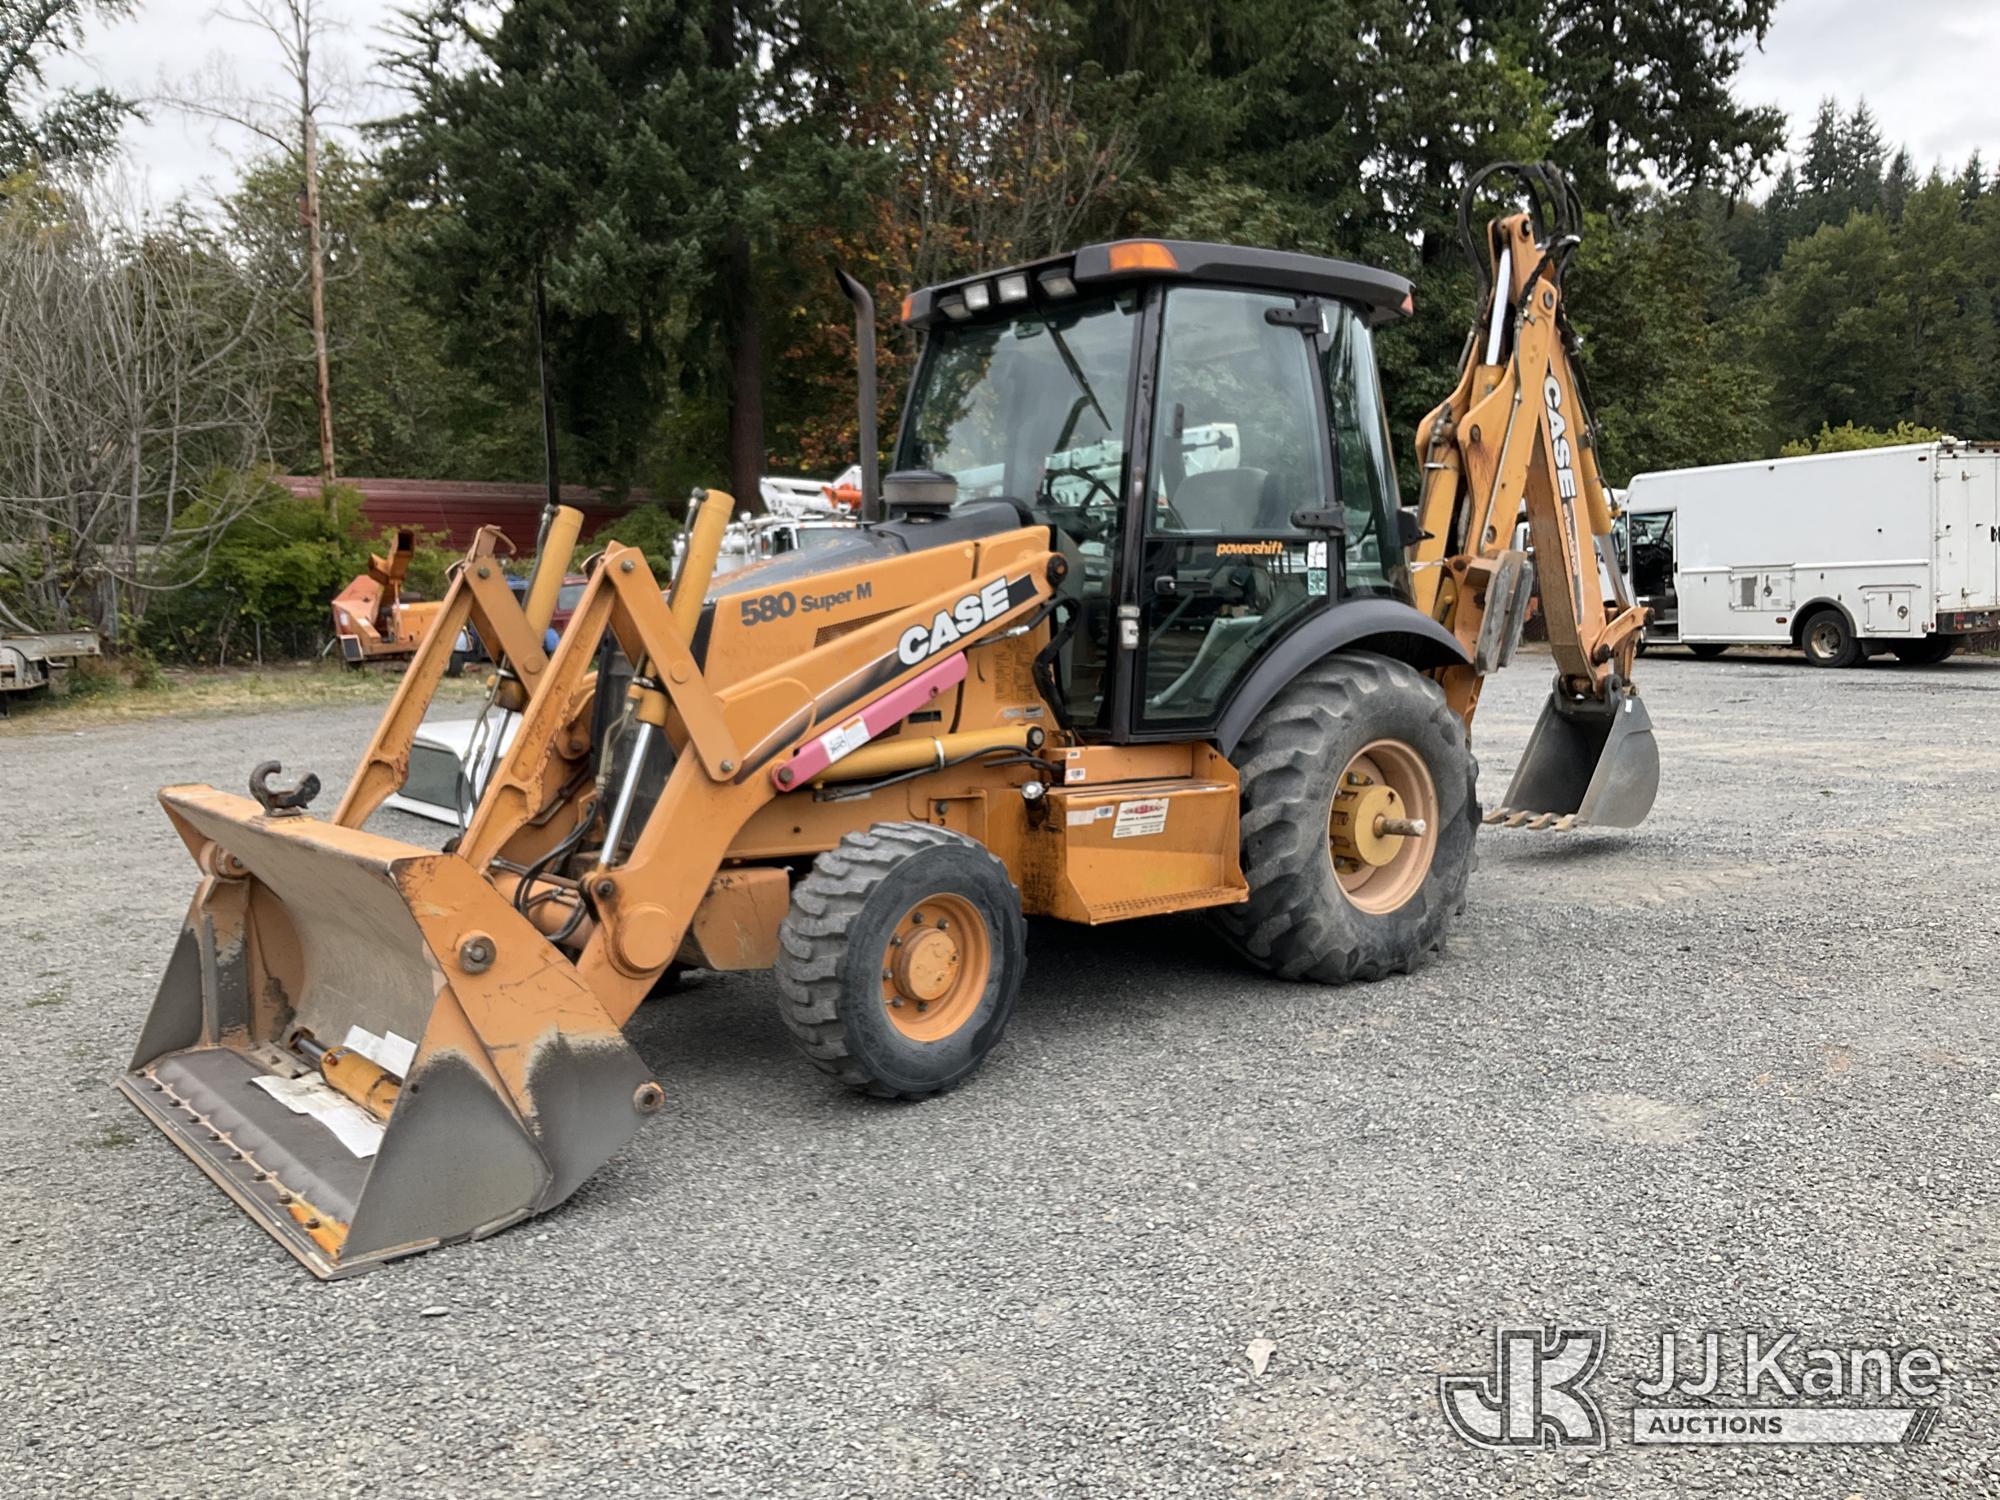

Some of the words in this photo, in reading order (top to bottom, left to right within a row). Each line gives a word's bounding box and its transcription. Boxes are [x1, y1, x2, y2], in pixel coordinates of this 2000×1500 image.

[1543, 375, 1577, 499] CASE
[1216, 540, 1284, 556] powershift
[741, 591, 796, 626] 580
[801, 590, 853, 612] Super
[857, 582, 872, 600] M
[897, 576, 1010, 666] CASE
